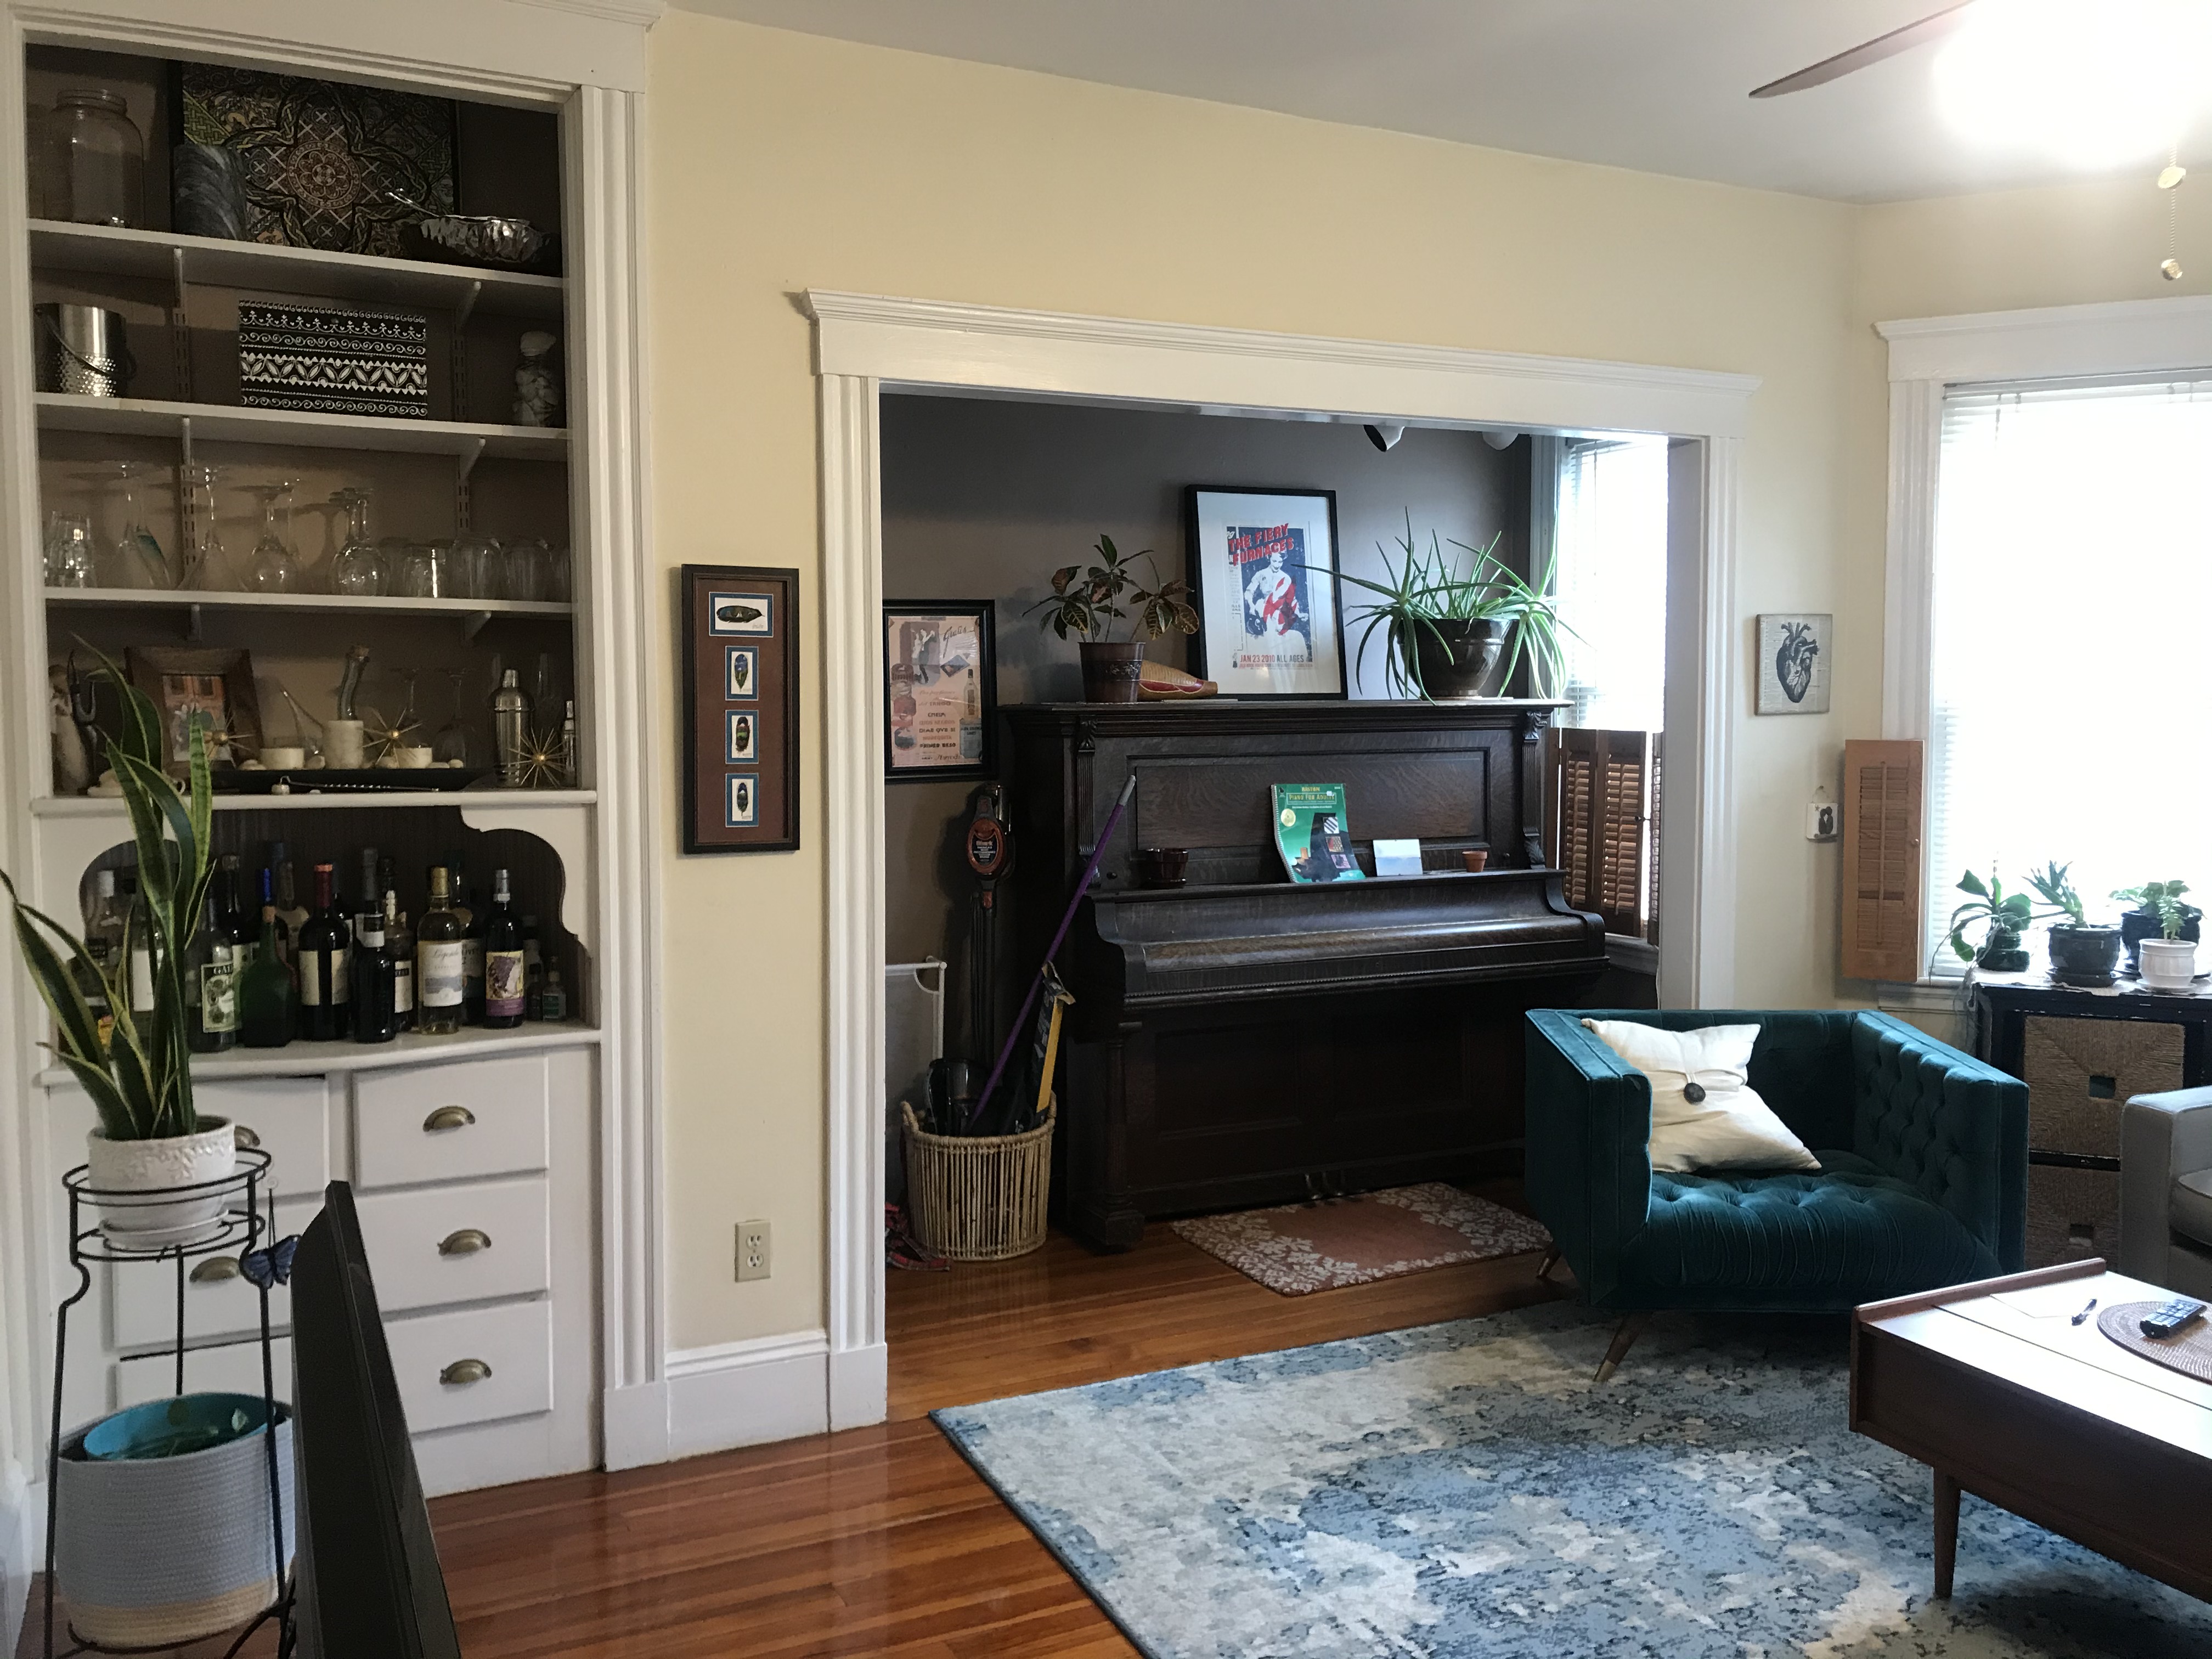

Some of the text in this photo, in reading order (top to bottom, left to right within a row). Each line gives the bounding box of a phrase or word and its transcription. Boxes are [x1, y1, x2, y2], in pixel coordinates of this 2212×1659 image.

[1228, 523, 1289, 552] THE FIERY
[1233, 537, 1294, 566] FURNACES
[1240, 654, 1304, 663] JAN 23 2010 ALL AGES
